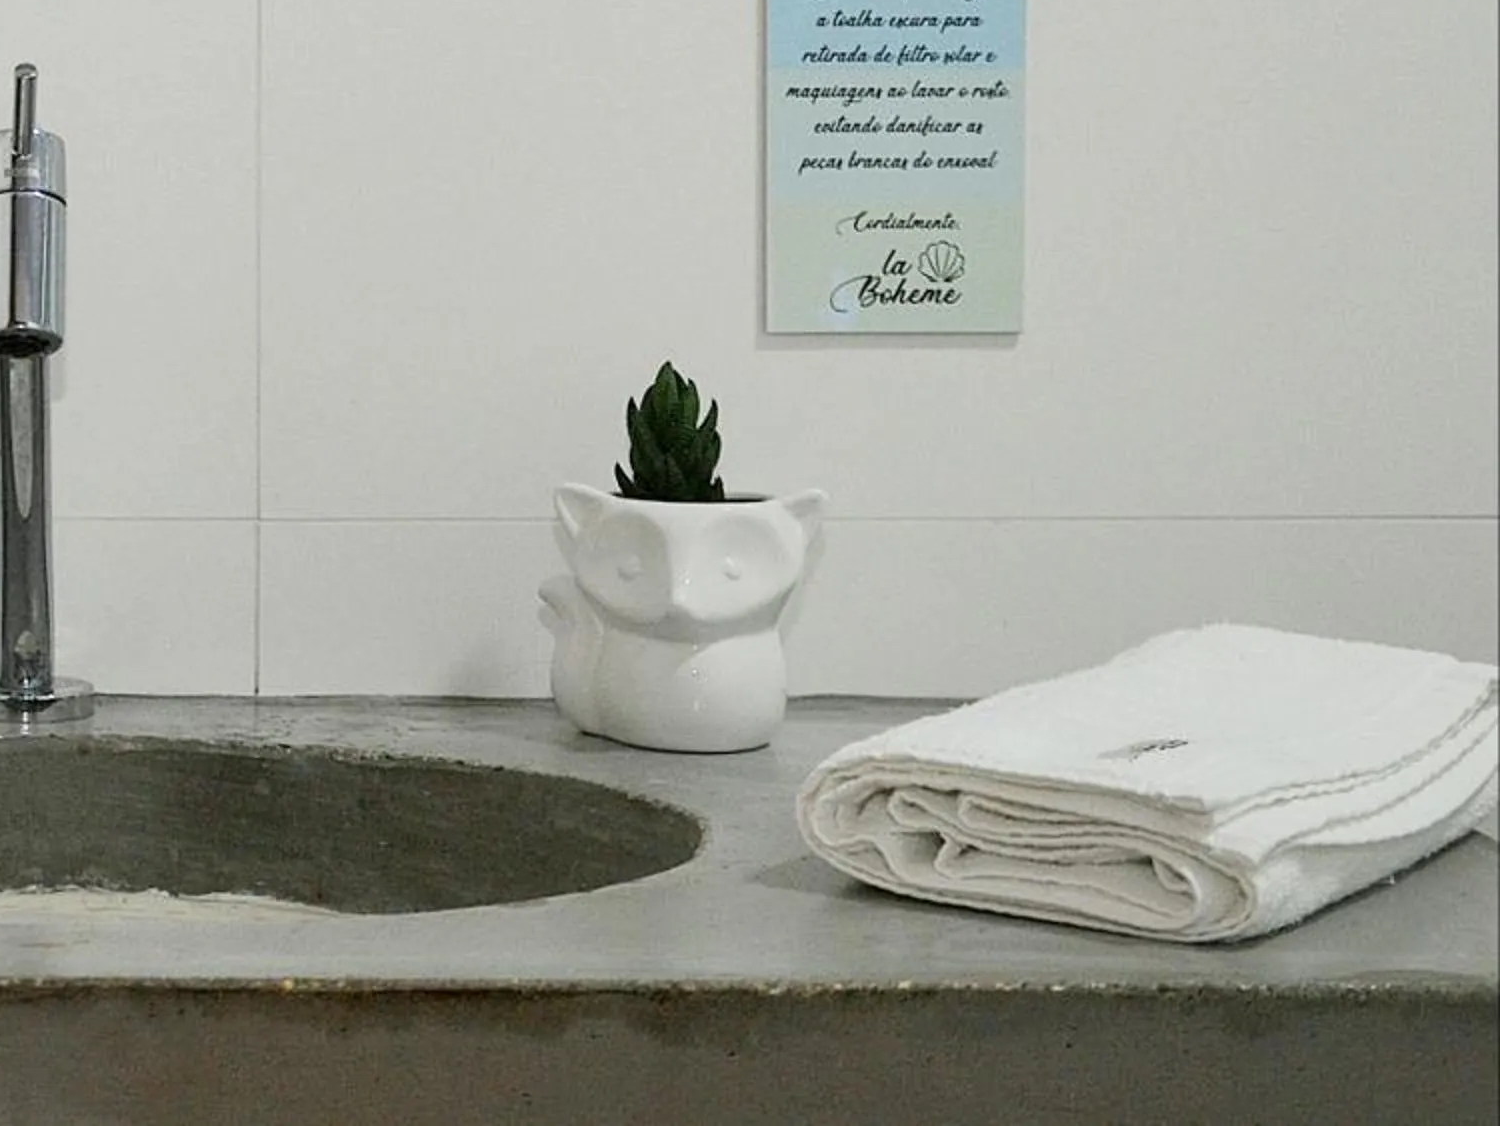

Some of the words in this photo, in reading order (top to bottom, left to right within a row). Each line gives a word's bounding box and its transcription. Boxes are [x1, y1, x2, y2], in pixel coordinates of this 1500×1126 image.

[816, 16, 828, 27] a
[832, 10, 886, 27] toalha
[888, 16, 941, 28] escura
[940, 16, 983, 34] para
[801, 44, 871, 63] retirada
[873, 44, 895, 63] de
[897, 44, 941, 66] filtro
[943, 44, 983, 64] solar
[985, 51, 996, 63] e
[786, 83, 883, 106] maquiagens
[887, 86, 907, 98] ao
[910, 80, 955, 98] lavar
[958, 87, 970, 98] o
[814, 115, 882, 134] evitando
[885, 115, 962, 136] danificar
[966, 122, 983, 134] as
[798, 154, 843, 175] peças
[847, 150, 908, 170] brancas
[912, 150, 934, 168] do
[936, 150, 998, 169] enxoval
